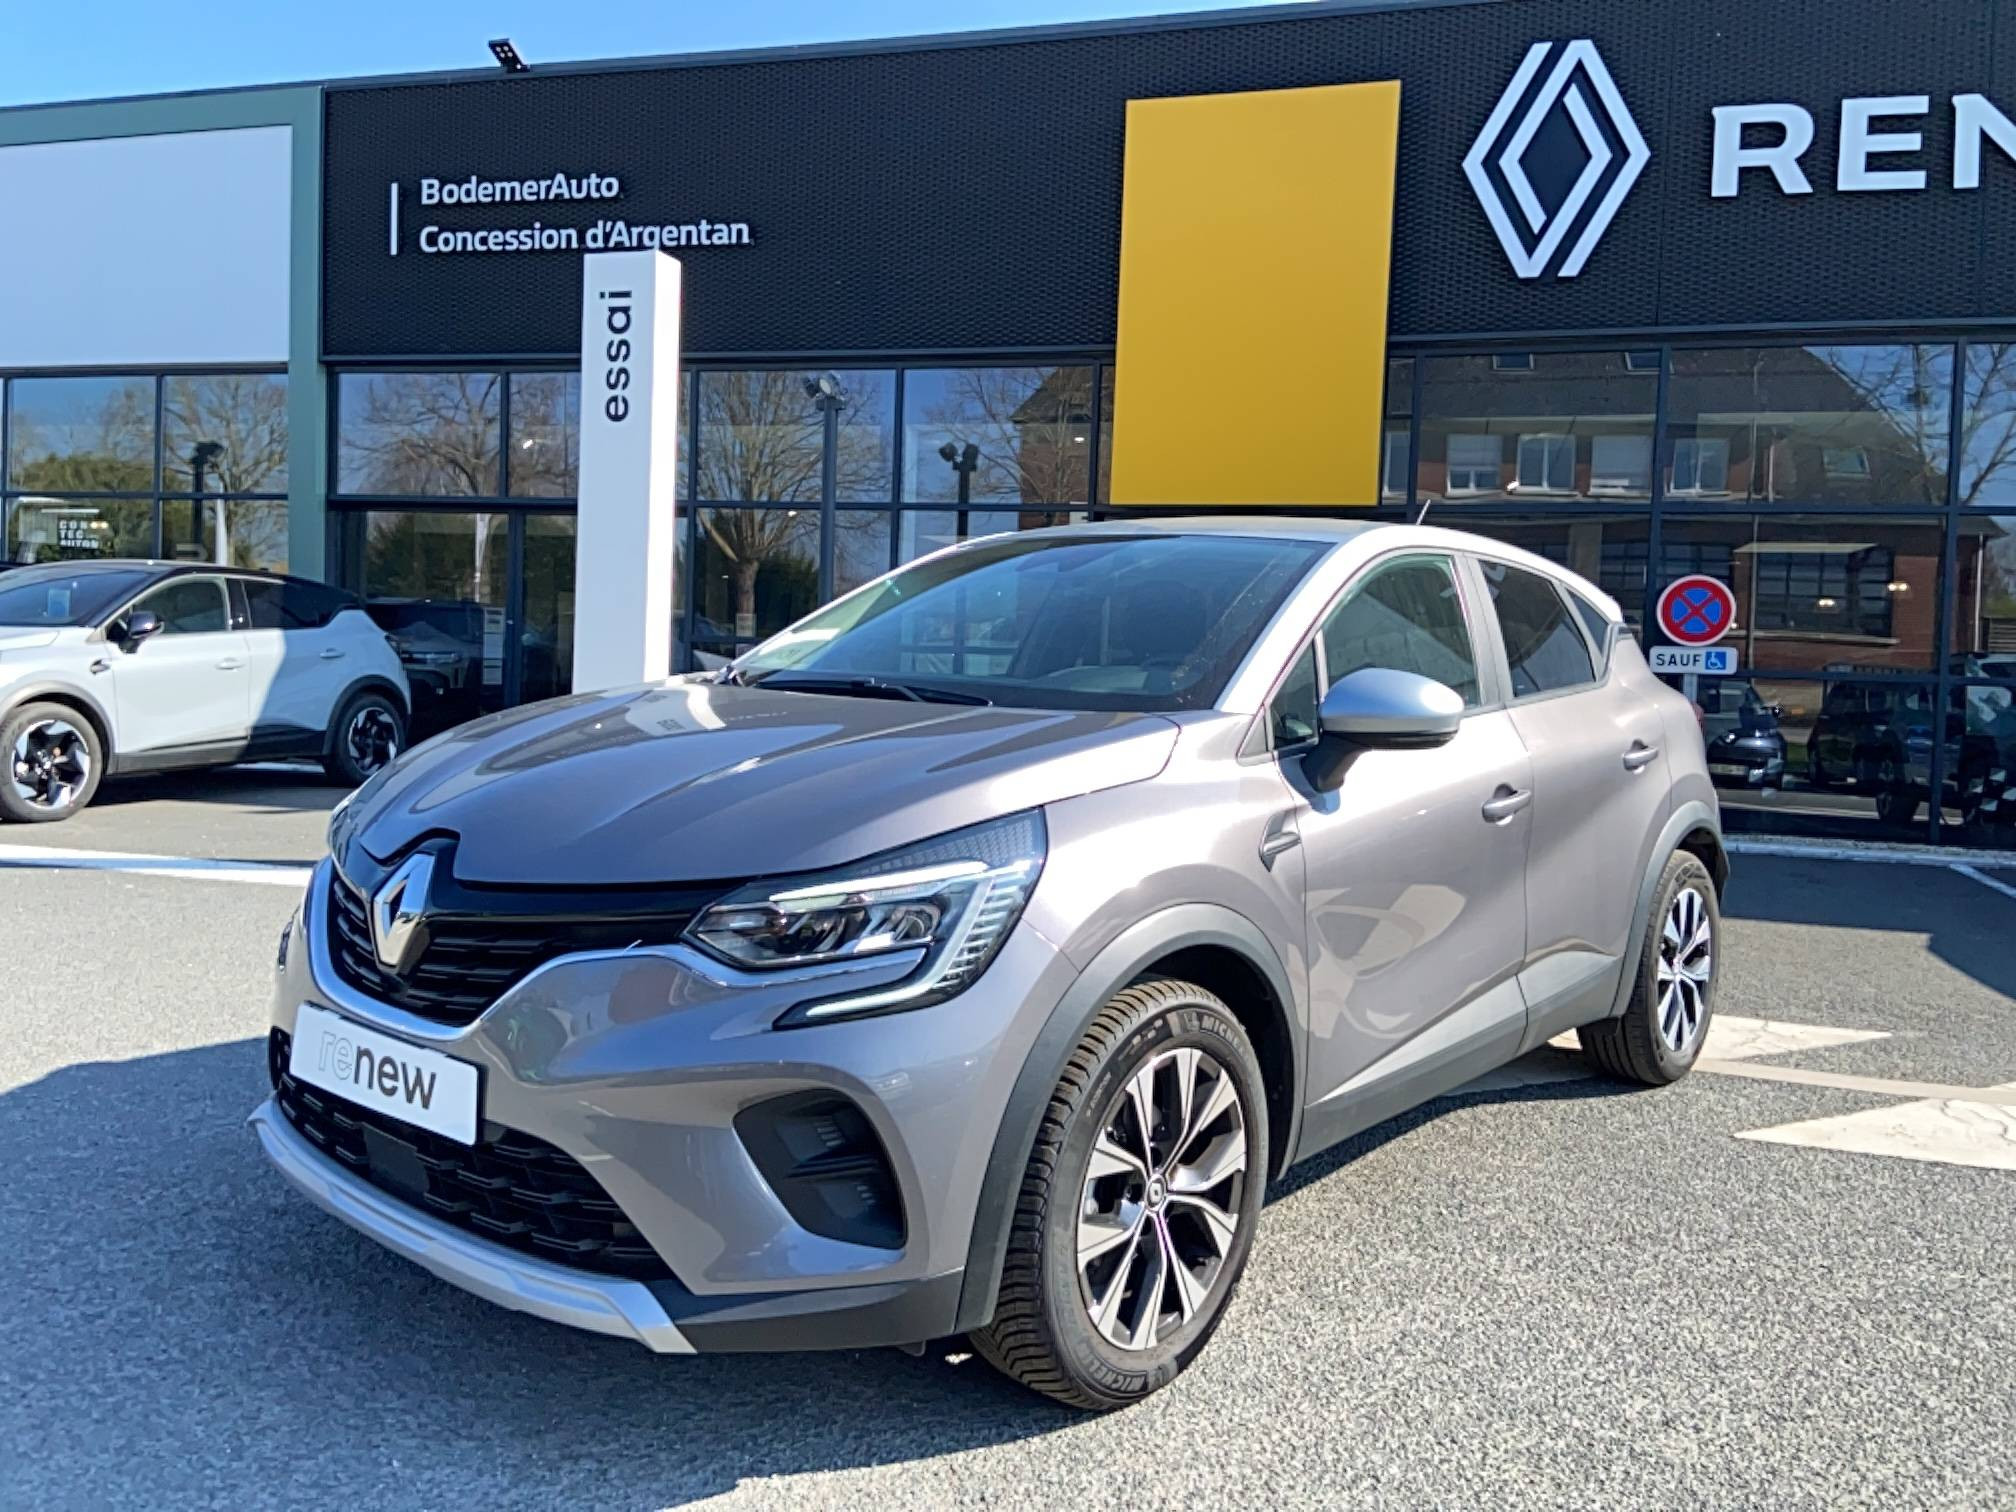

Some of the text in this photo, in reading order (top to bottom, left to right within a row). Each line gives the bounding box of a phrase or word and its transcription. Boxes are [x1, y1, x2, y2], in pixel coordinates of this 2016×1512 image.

[420, 173, 620, 205] BodemerAuto
[419, 219, 751, 253] Concession d'Argentan
[599, 290, 632, 422] essai
[1656, 653, 1702, 667] SAUF
[318, 1030, 437, 1110] renew
